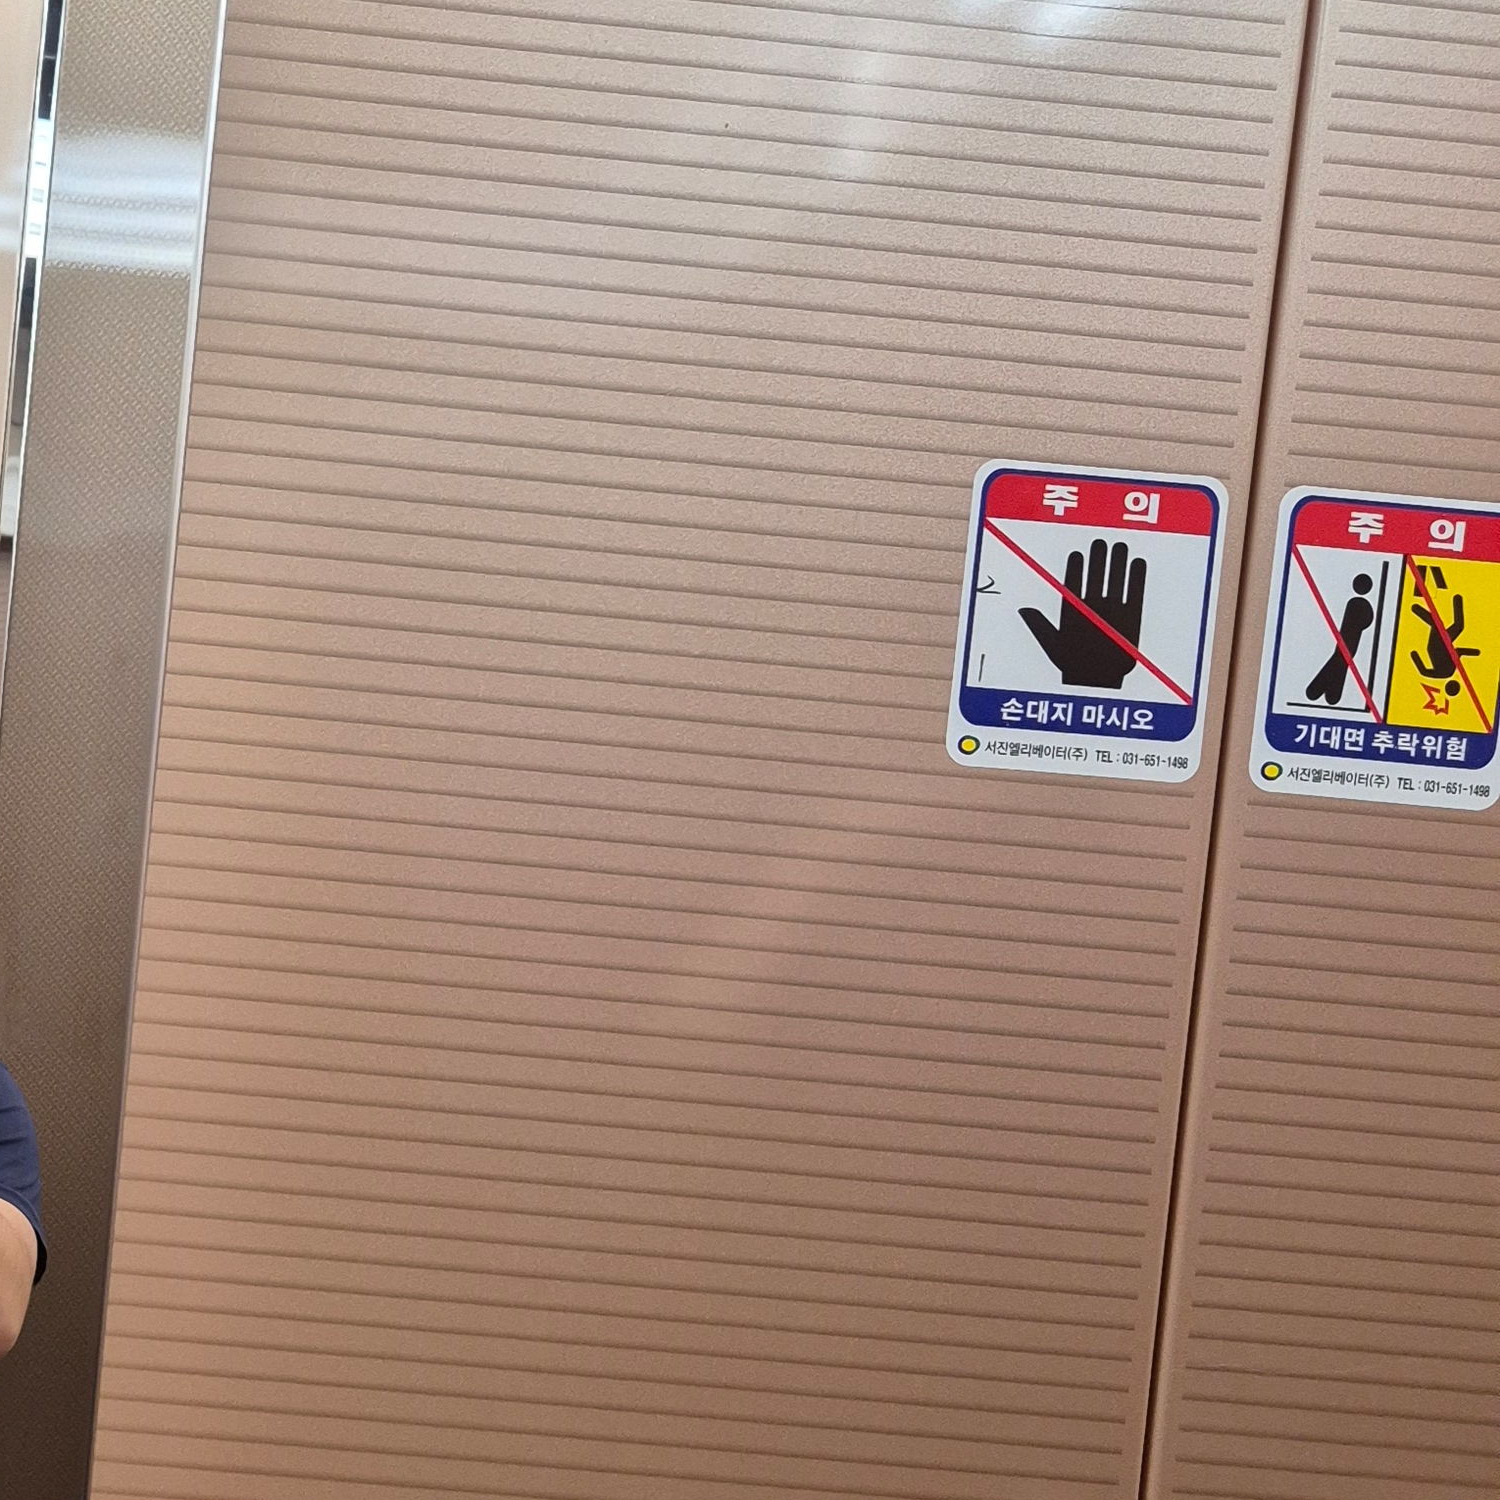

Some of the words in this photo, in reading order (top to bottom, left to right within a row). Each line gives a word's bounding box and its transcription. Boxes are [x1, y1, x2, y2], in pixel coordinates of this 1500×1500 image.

[999, 697, 1074, 727] 손대지
[1082, 706, 1155, 731] 마시오
[984, 740, 1088, 763] 서진엘리베이터(주)
[1294, 723, 1366, 752] 기대면
[1370, 730, 1468, 762] 추락위험
[1286, 766, 1390, 790] 서진엘리베이터(주)
